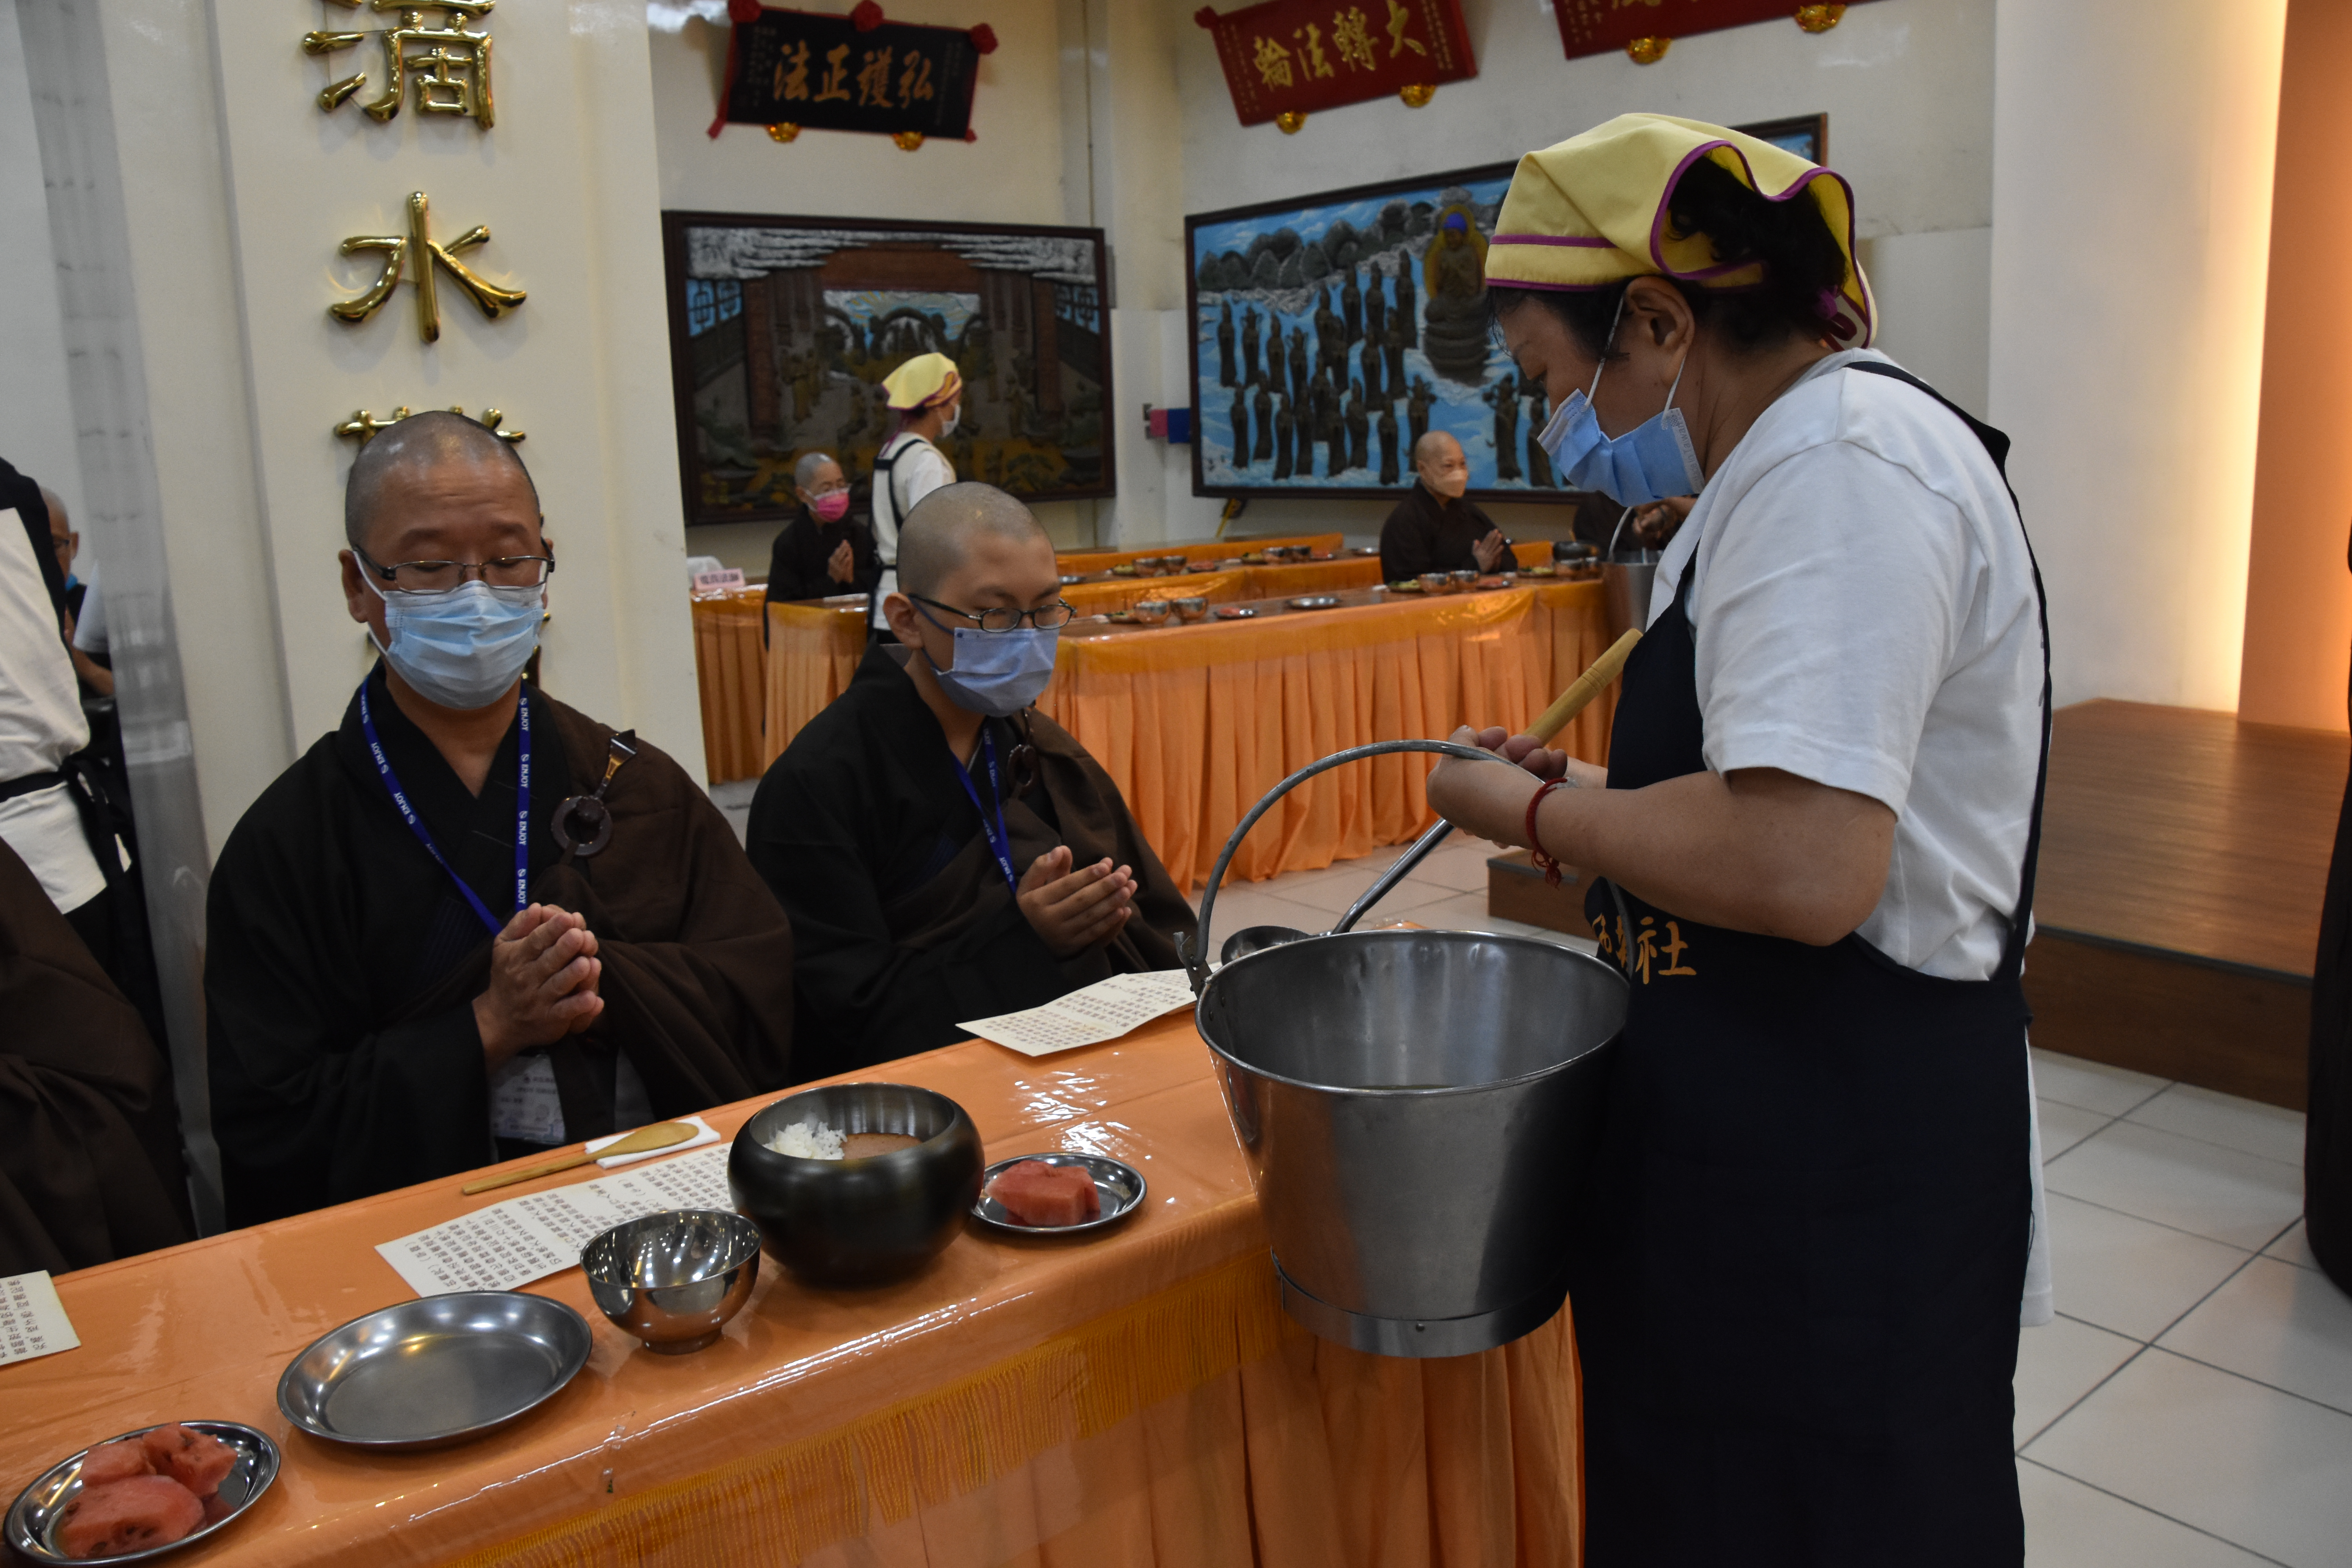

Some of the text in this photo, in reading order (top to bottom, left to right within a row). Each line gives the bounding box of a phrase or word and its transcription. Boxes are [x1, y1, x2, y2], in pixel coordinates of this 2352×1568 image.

[303, 0, 527, 444] 滴水
[521, 707, 529, 731] ENJOY
[371, 742, 385, 765] ENJOY
[521, 764, 529, 788] ENJOY
[393, 792, 411, 815] ENJOY
[519, 821, 527, 846] ENJOY
[999, 857, 1011, 875] ENJOY
[518, 879, 526, 904] ENJOY
